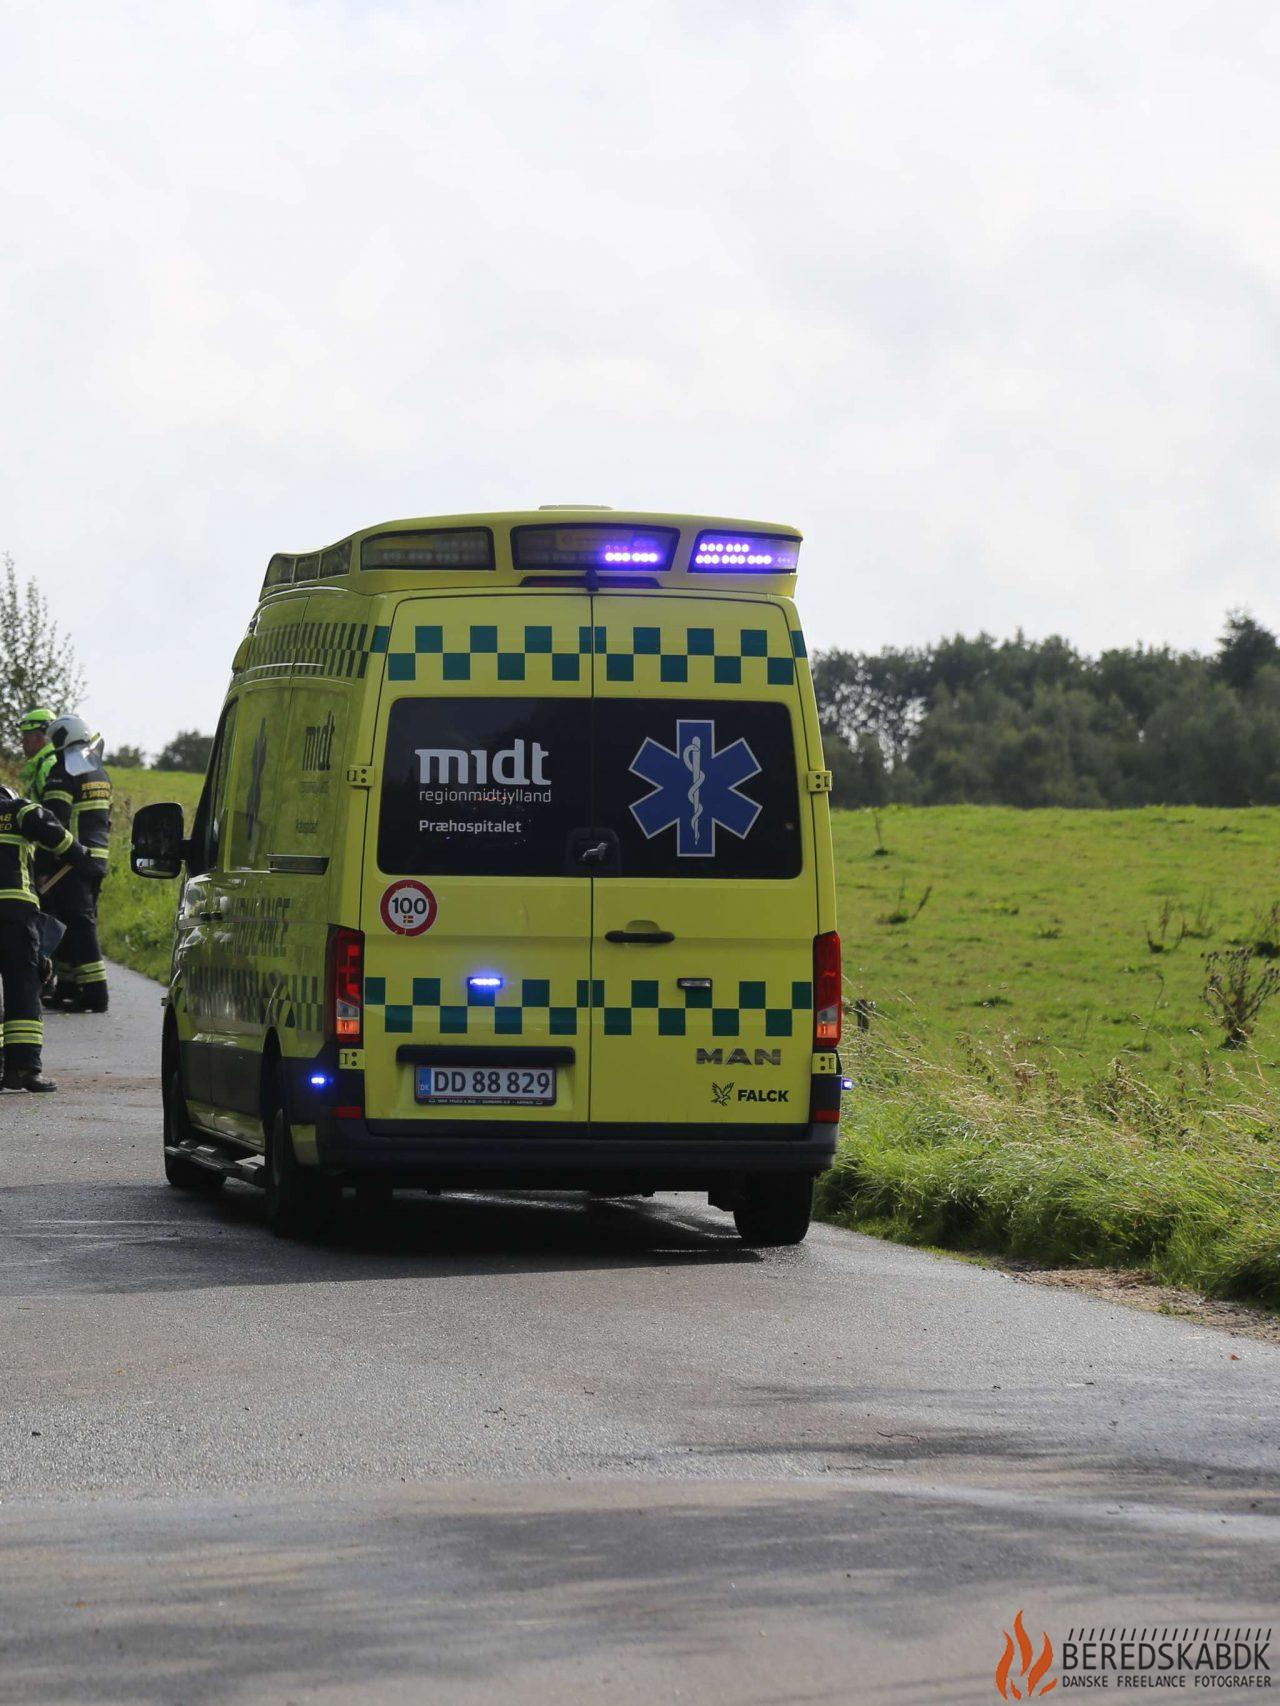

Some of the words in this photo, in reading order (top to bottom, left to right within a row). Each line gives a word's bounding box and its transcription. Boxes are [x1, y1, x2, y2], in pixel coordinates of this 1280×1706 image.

[414, 738, 552, 785] midt
[419, 788, 551, 805] regionmidtjylland
[419, 819, 522, 834] Præhospitalet
[392, 897, 427, 914] 100
[696, 1048, 781, 1066] MAN
[434, 1071, 466, 1092] DD
[472, 1071, 501, 1093] 88
[507, 1072, 550, 1094] 829
[738, 1089, 789, 1102] FALCK
